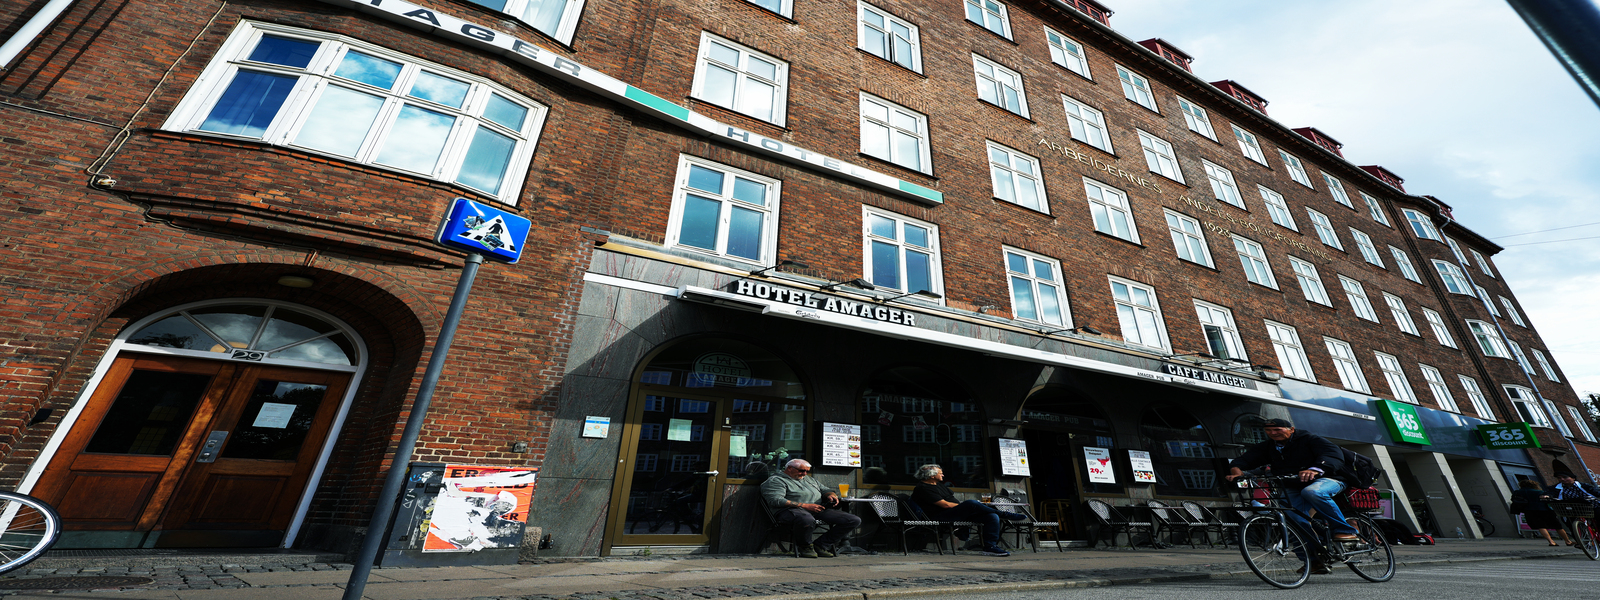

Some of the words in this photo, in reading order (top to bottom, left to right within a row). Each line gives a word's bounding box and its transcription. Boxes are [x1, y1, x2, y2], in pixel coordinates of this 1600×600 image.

[726, 126, 866, 179] HOTEL
[1037, 138, 1163, 194] ARBEIDERNES
[736, 279, 818, 309] HOTEL
[823, 297, 916, 327] AMAGER
[232, 349, 263, 361] 29
[702, 365, 745, 377] HOTEL
[703, 373, 744, 384] AMAGER
[1167, 364, 1200, 380] CAFE
[1202, 371, 1247, 388] AMAGER
[1392, 411, 1419, 431] 365
[1485, 428, 1525, 442] 365
[1491, 439, 1529, 447] discount
